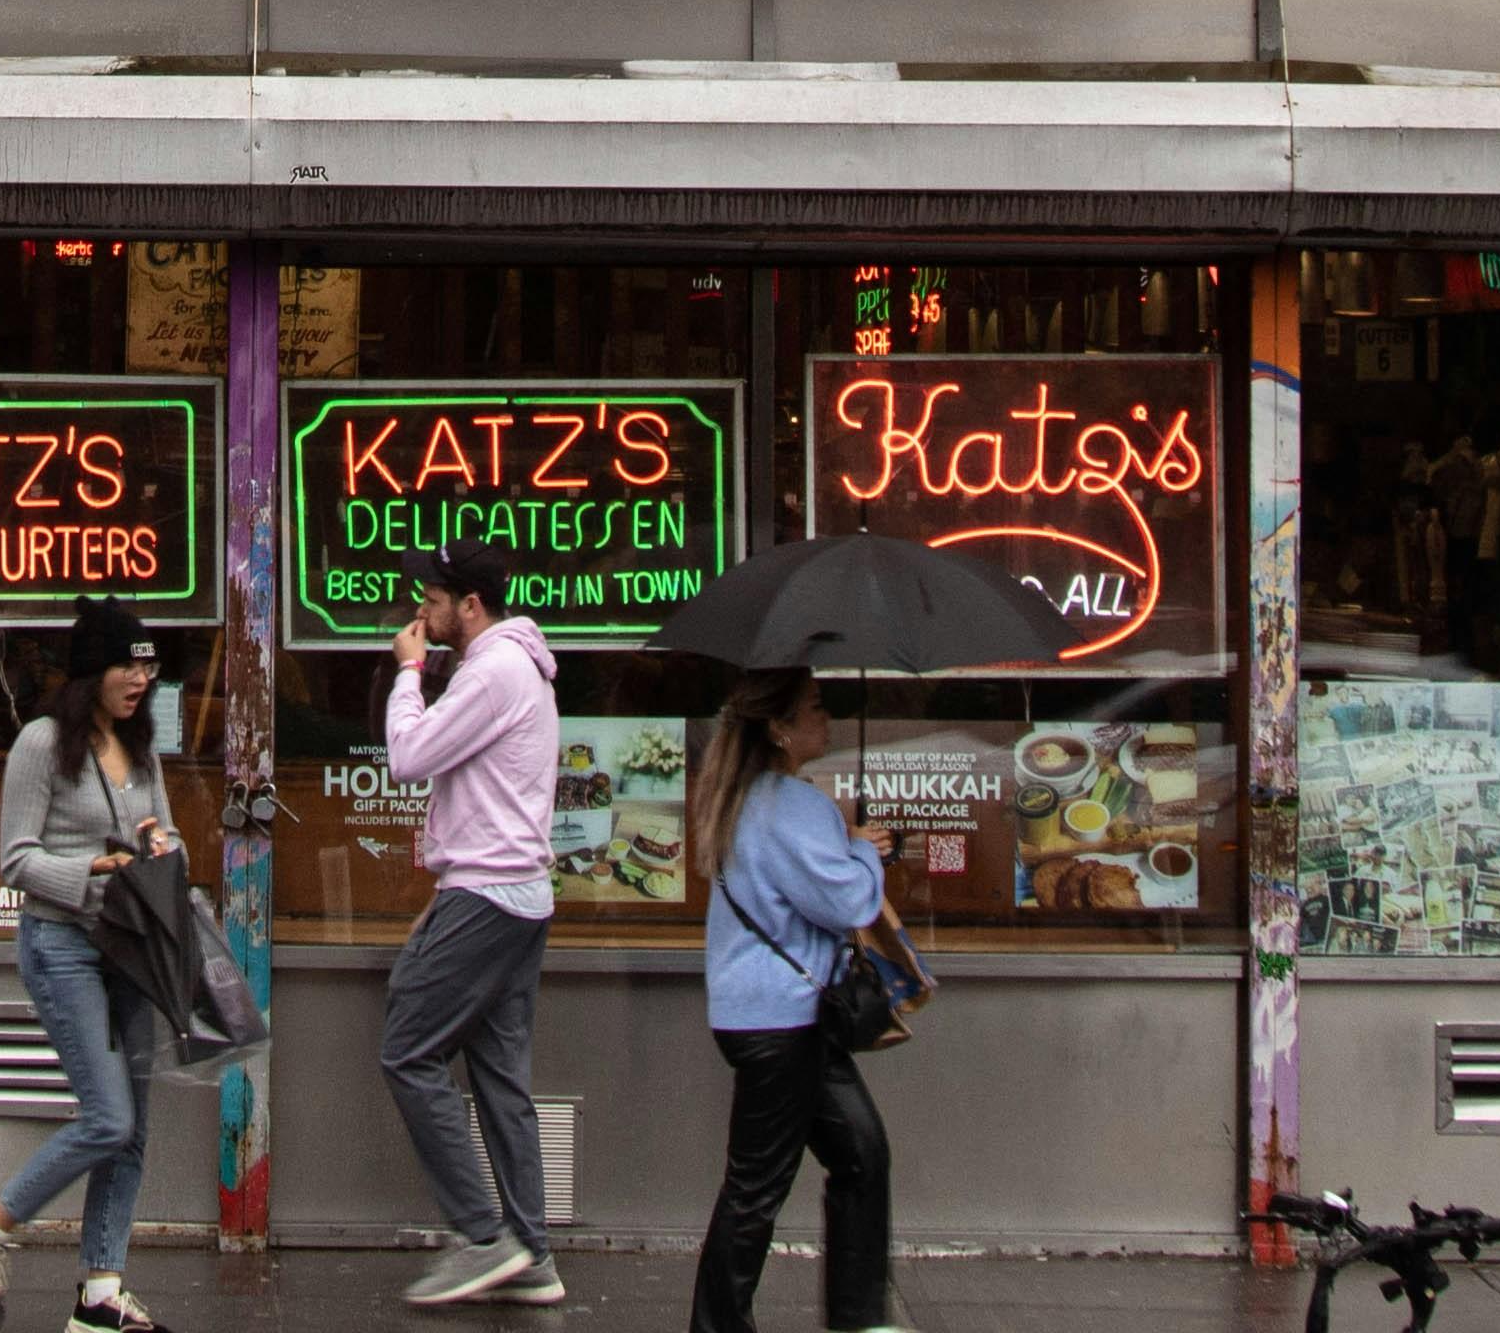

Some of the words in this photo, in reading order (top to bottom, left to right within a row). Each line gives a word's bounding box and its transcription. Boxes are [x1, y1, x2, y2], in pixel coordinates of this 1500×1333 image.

[346, 403, 670, 495] KATZ'S
[327, 570, 401, 603] BEST
[572, 575, 604, 605] IN
[614, 569, 702, 603] TOWN
[1061, 575, 1131, 616] ALL
[864, 752, 881, 761] IVE
[884, 752, 902, 761] THE
[904, 752, 925, 762] GIFT
[927, 752, 941, 762] OF
[864, 762, 884, 771] THIS
[886, 762, 928, 771] HOLIDAY
[324, 765, 434, 798] HOLD
[834, 773, 1001, 800] HANUKKAH
[353, 799, 386, 812] GIFT
[866, 803, 900, 817] GIFT
[903, 804, 969, 817] PACKAGE
[345, 815, 391, 826] INCLUDES
[392, 816, 416, 826] FREE
[906, 820, 930, 830] FREE
[932, 820, 978, 830] SHIPPING
